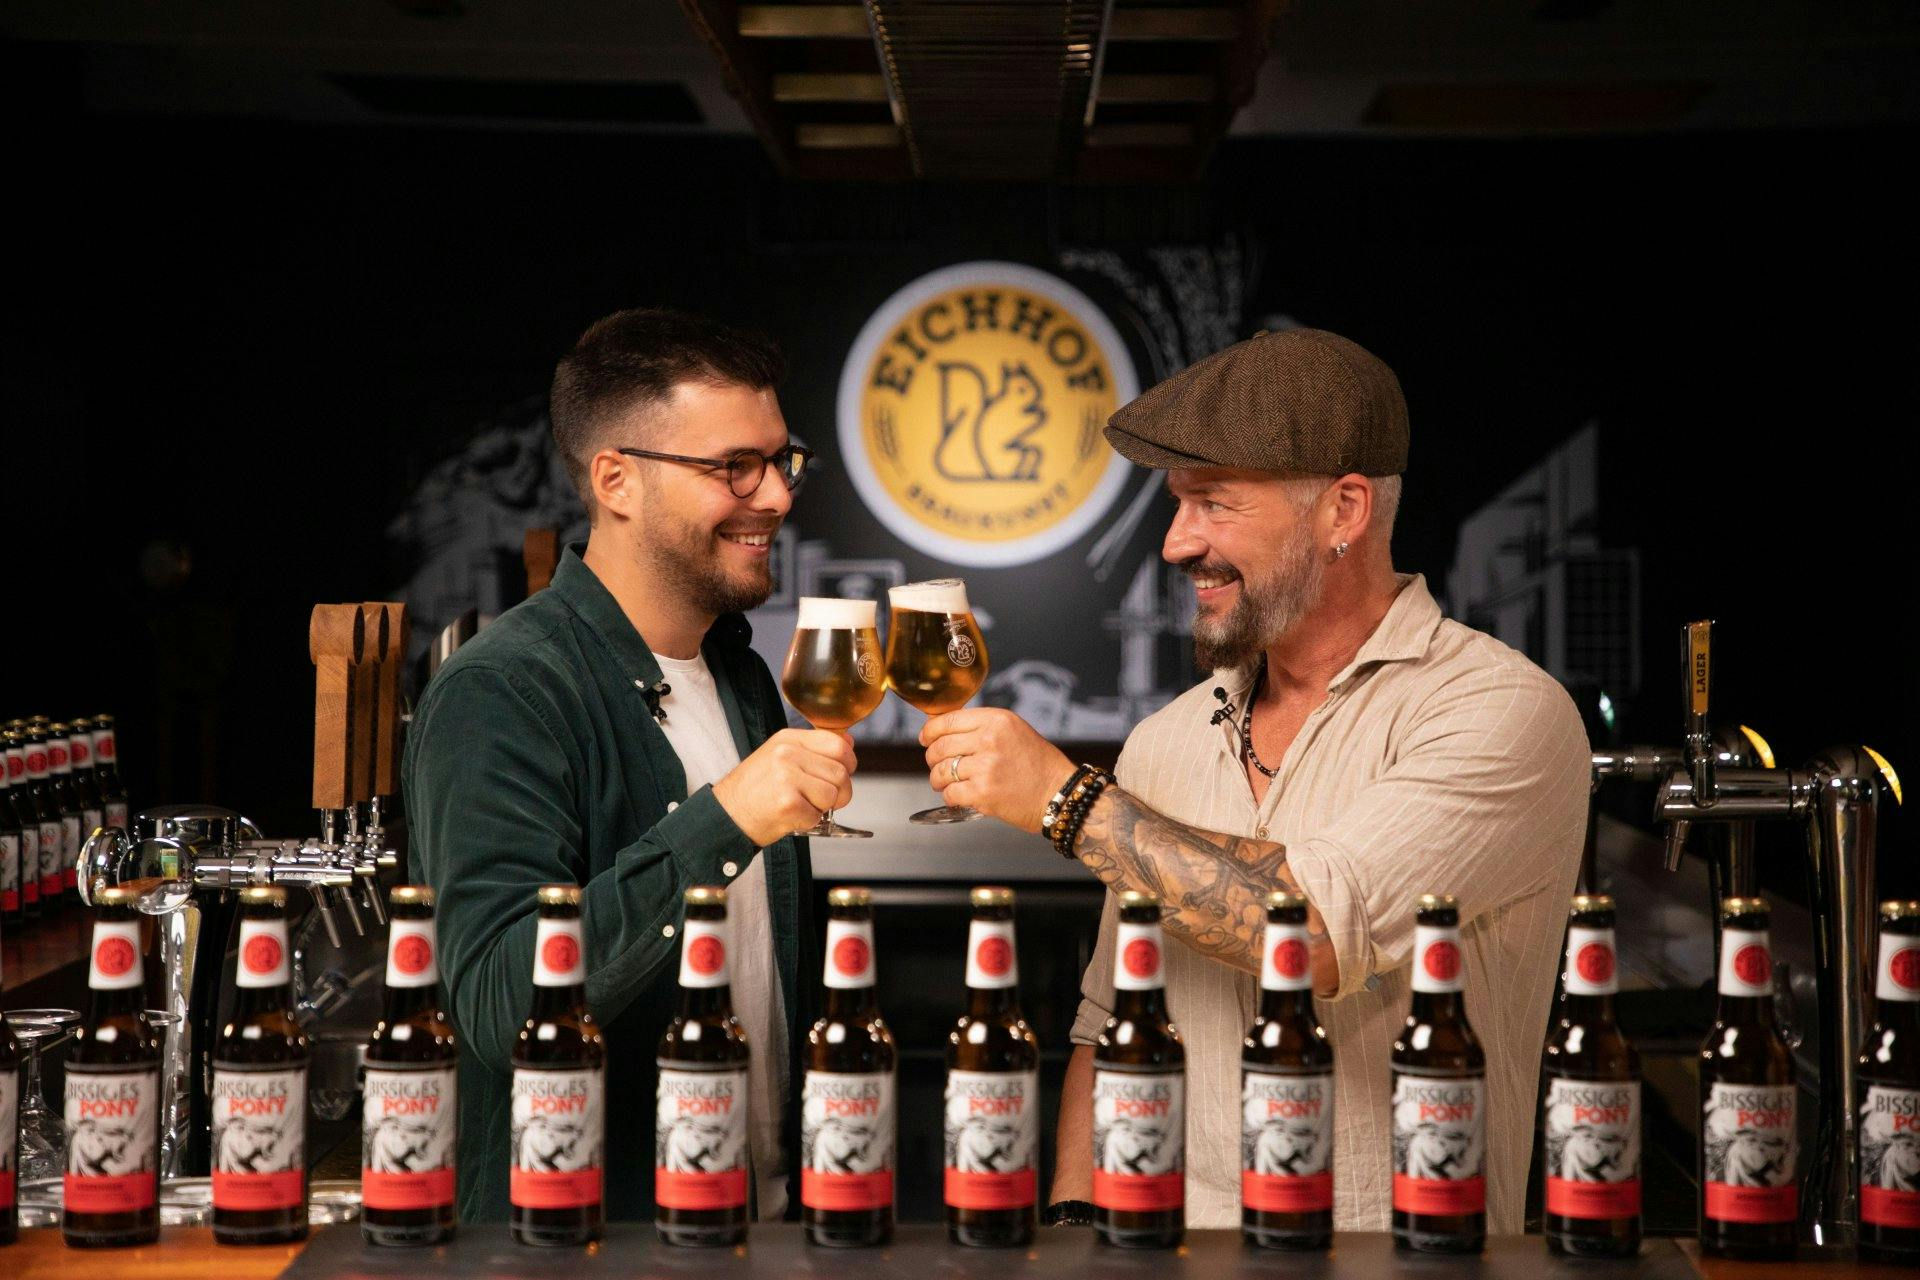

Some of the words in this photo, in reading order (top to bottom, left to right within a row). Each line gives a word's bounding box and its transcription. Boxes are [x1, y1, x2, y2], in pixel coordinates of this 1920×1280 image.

[872, 293, 1107, 397] EICHHOF
[1696, 653, 1706, 693] LAGER
[65, 1080, 139, 1099] BISSIGES
[215, 1080, 288, 1099] BISSIGES
[368, 1079, 440, 1098] BISSIGES
[516, 1079, 588, 1098] BISSIGES
[1405, 1085, 1475, 1104] BISSIGES
[80, 1098, 139, 1119] PONY
[229, 1098, 287, 1117] PONY
[383, 1097, 438, 1115] PONY
[532, 1097, 587, 1114] PONY
[678, 1097, 732, 1116] PONY
[826, 1098, 879, 1117] PONY
[970, 1097, 1022, 1116] PONY
[1116, 1099, 1168, 1118] PONY
[1268, 1100, 1319, 1118] PONY
[1719, 1091, 1793, 1111] BISSIGES
[1420, 1103, 1471, 1122] PONY
[1574, 1106, 1627, 1124] PONY
[1737, 1109, 1793, 1130] PONY
